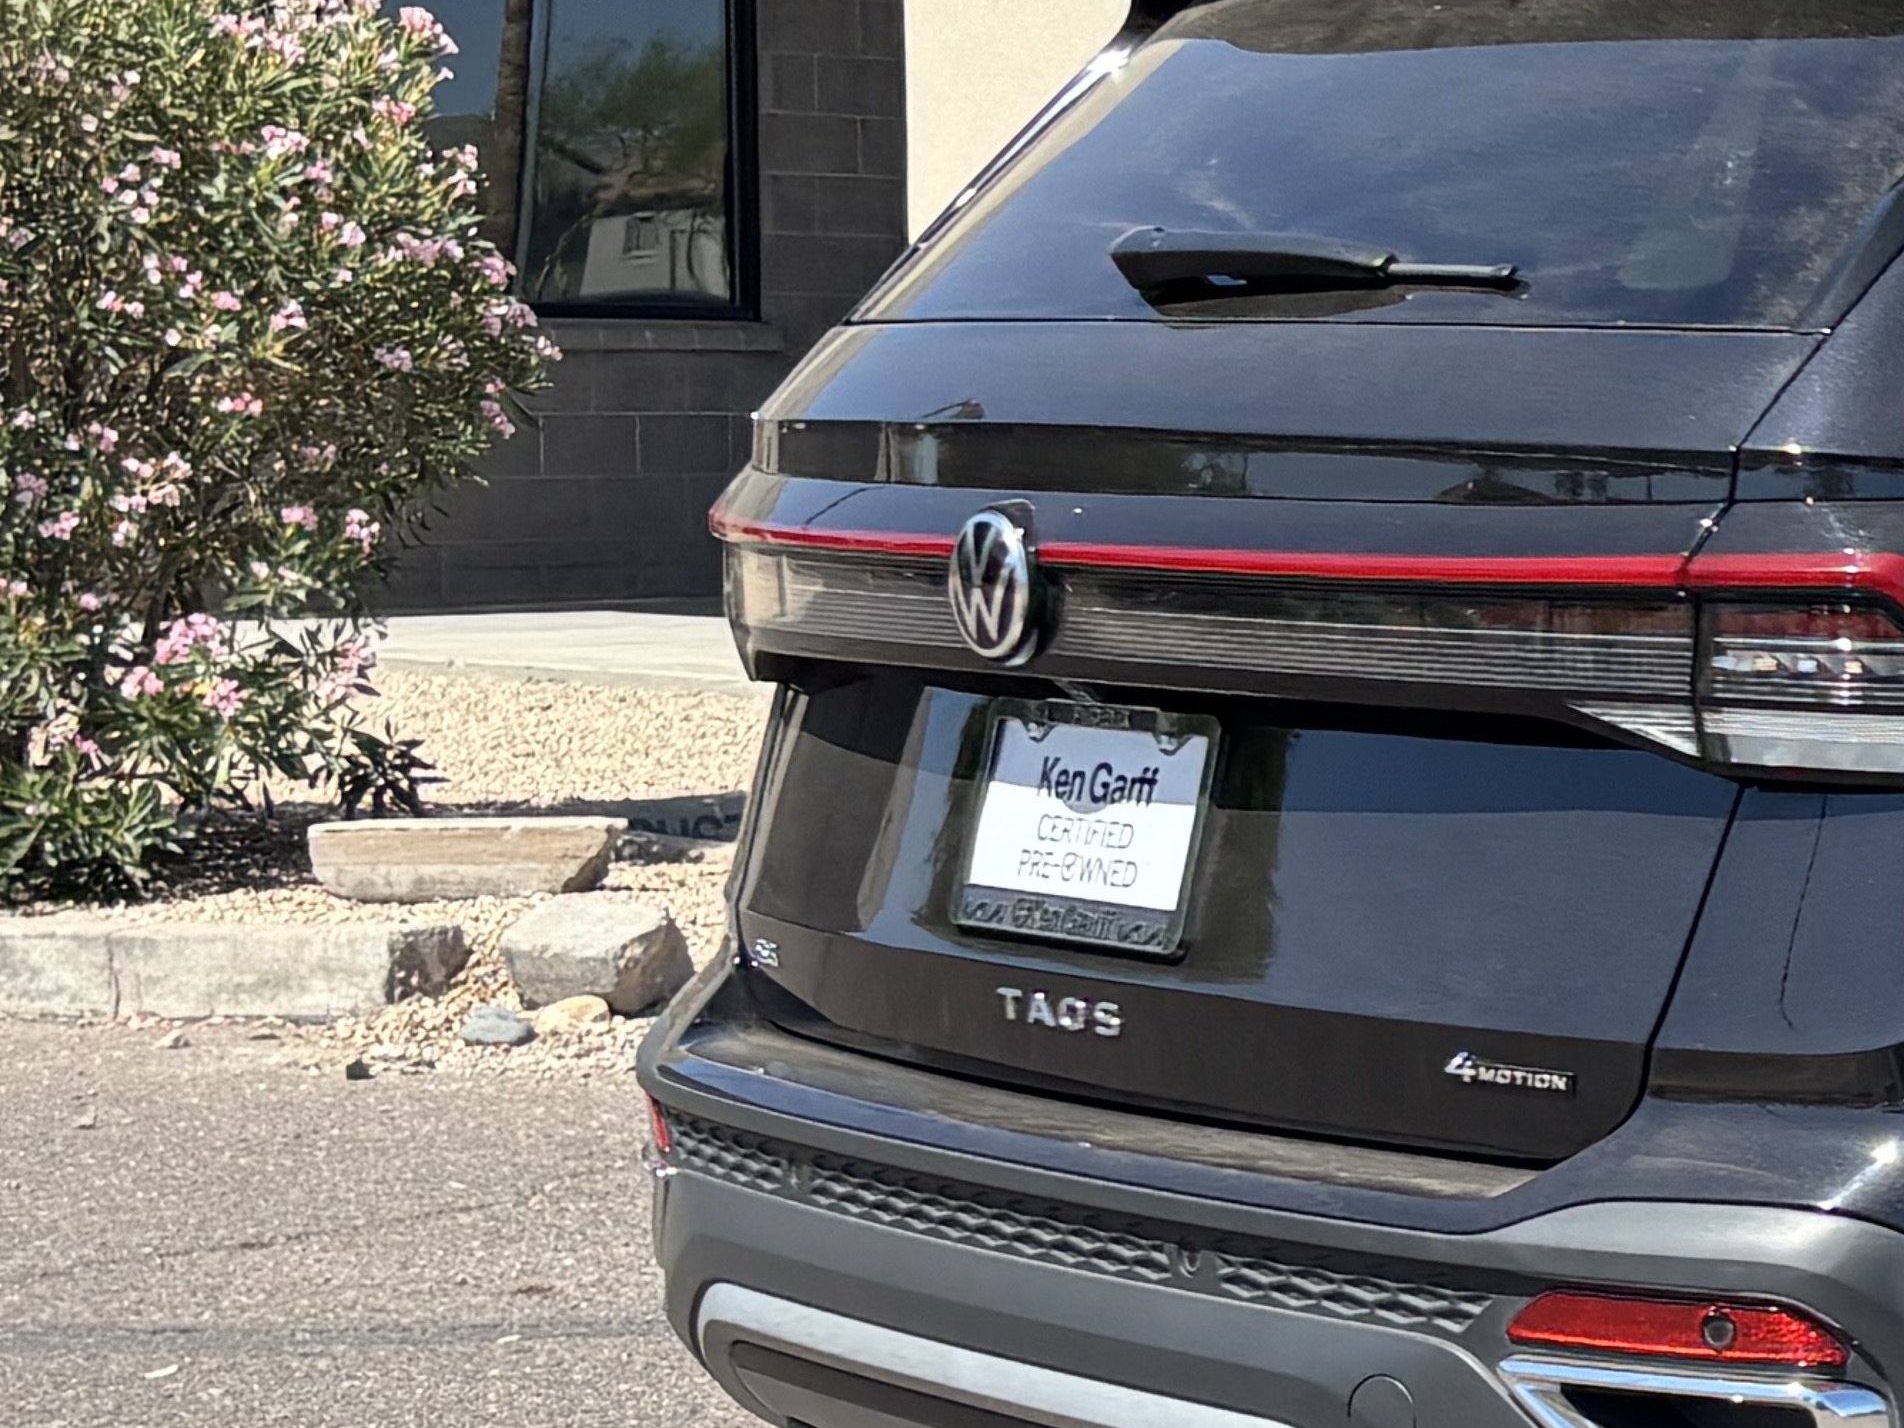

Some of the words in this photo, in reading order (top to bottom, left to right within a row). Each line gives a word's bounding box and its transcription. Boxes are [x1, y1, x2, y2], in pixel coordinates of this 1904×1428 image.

[1038, 755, 1086, 804] Ken
[1089, 761, 1161, 809] Garff
[1037, 813, 1135, 850] CERTIFIED
[1017, 848, 1139, 889] PRE-OWNED
[995, 986, 1122, 1037] TAOS
[1443, 1051, 1569, 1092] 4MOTION
